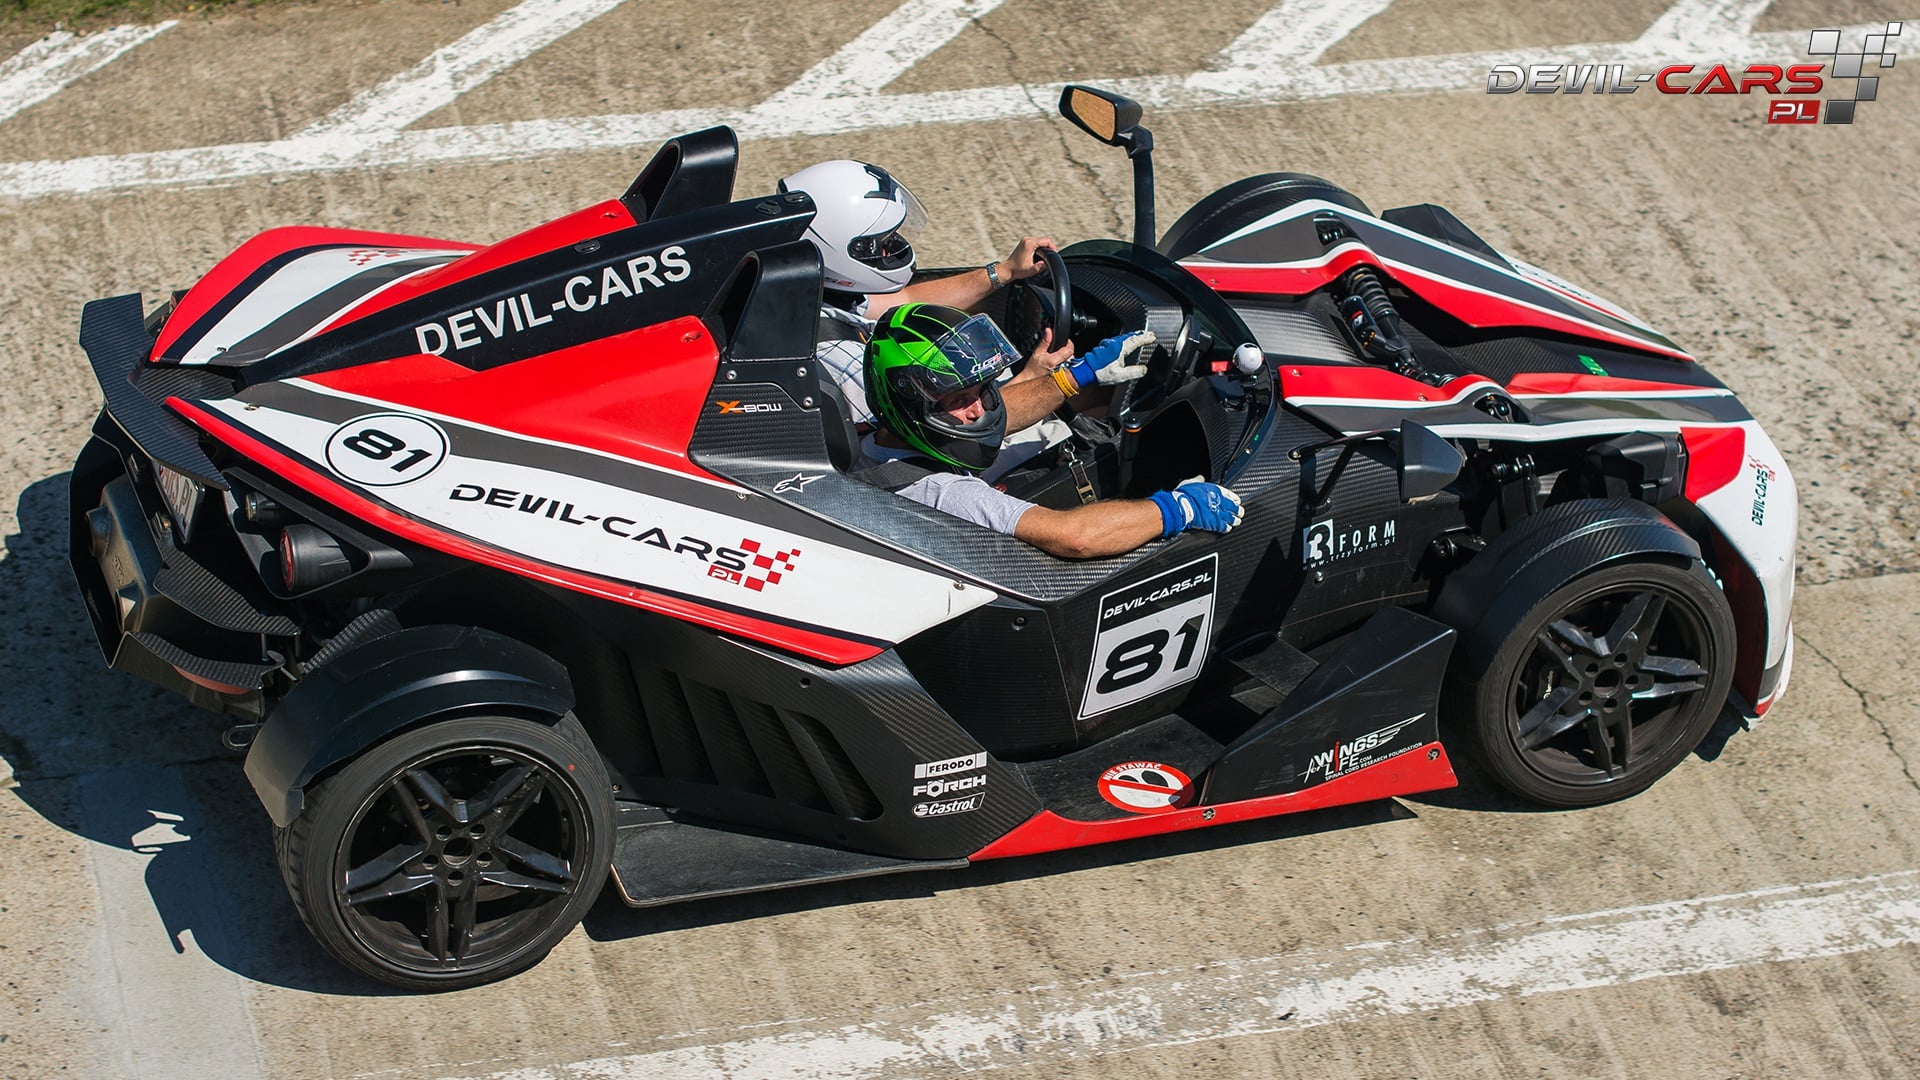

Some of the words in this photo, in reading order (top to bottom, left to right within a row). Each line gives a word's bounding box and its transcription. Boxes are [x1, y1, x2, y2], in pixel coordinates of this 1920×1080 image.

[415, 245, 692, 357] DEVIL-CARS
[342, 428, 433, 473] 81
[1751, 468, 1769, 526] DEVIL-CARS
[448, 483, 749, 571] DEVIL-CARS
[1339, 519, 1396, 552] FORM
[710, 567, 740, 585] PL
[1103, 572, 1212, 620] DEVIL-CARS.PL
[1096, 613, 1206, 695] 81
[929, 758, 974, 774] FERODO
[1102, 769, 1118, 781] NIE
[1325, 770, 1344, 781] SPINAL
[1344, 763, 1360, 775] CORD
[1360, 752, 1388, 769] RESEARCH
[1388, 741, 1423, 759] FOUNDATION
[928, 797, 976, 815] Castrol
